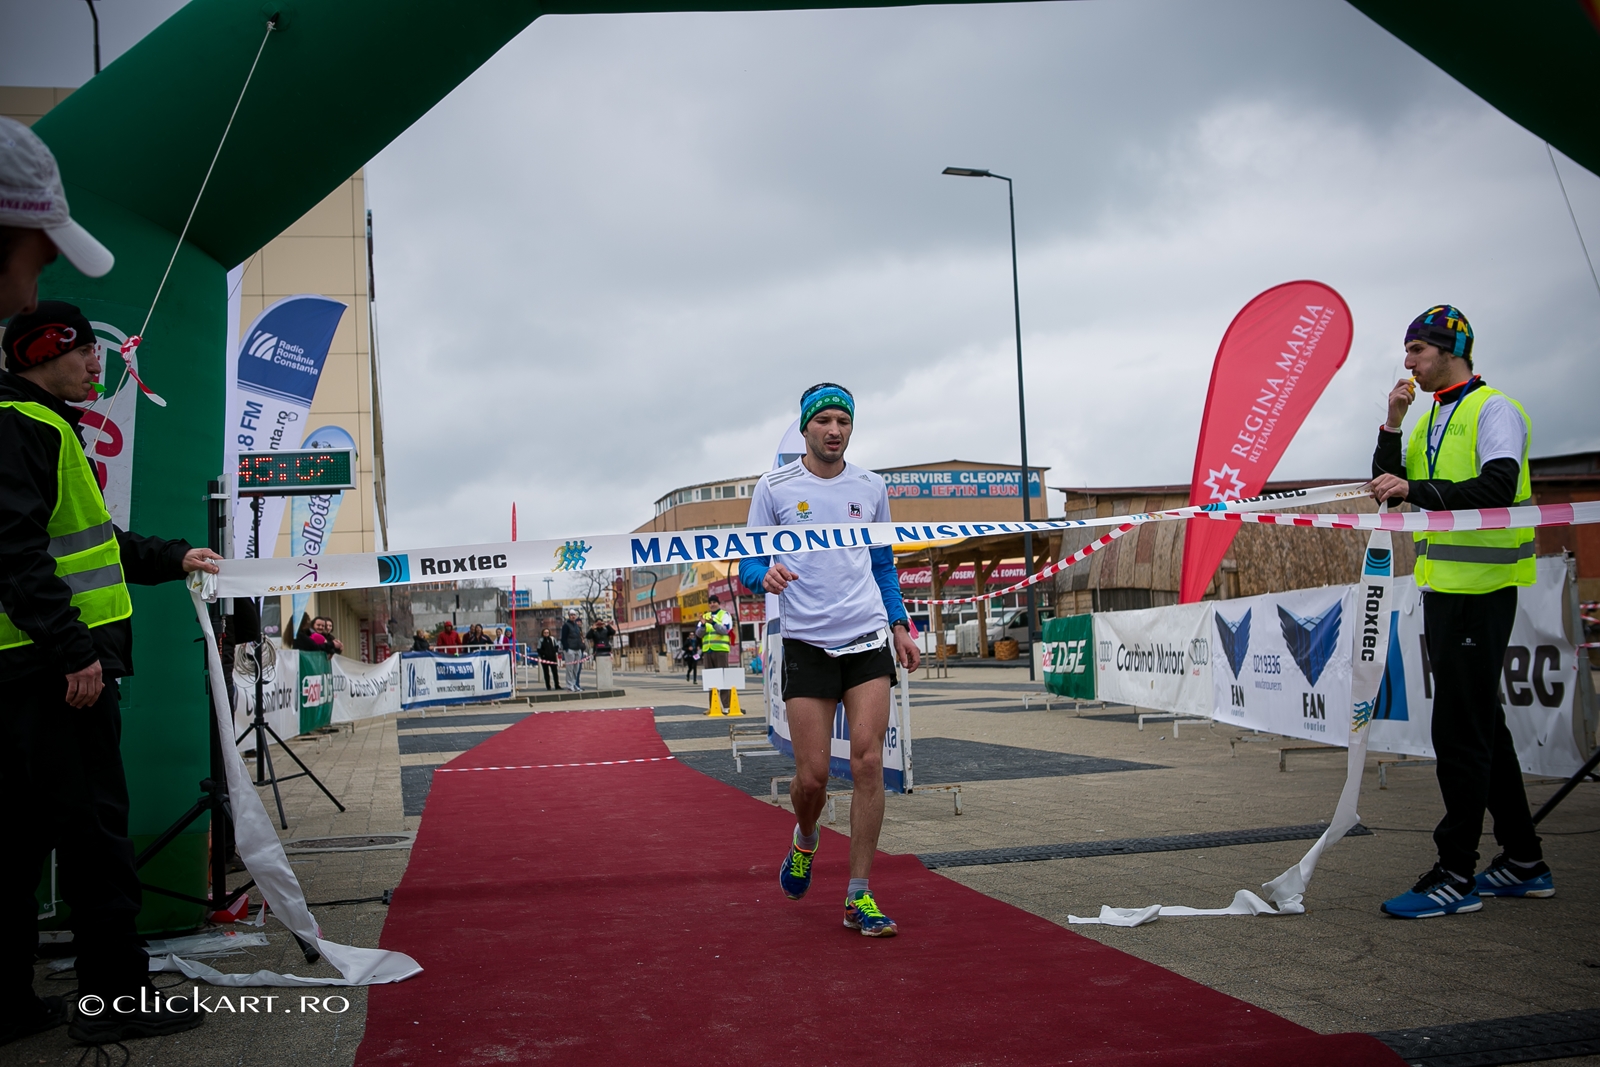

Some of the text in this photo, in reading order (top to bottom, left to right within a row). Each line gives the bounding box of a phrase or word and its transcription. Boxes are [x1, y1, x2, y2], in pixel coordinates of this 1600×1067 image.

[276, 348, 314, 366] România
[278, 340, 304, 354] Radio
[1294, 358, 1308, 374] DE
[1231, 304, 1324, 458] REGINA MARIA
[240, 400, 263, 431] FM
[886, 485, 920, 497] APID
[931, 485, 978, 497] IEFTIN
[989, 484, 1019, 496] BUN
[630, 526, 884, 565] MARATONUL
[420, 554, 507, 576] Roxtec
[304, 581, 347, 590] SPORT
[1361, 585, 1385, 662] Roxtec
[1117, 643, 1185, 675] Cardinal Motors
[1231, 685, 1245, 707] FAN
[1303, 692, 1326, 720] FAN
[1304, 721, 1326, 732] courier
